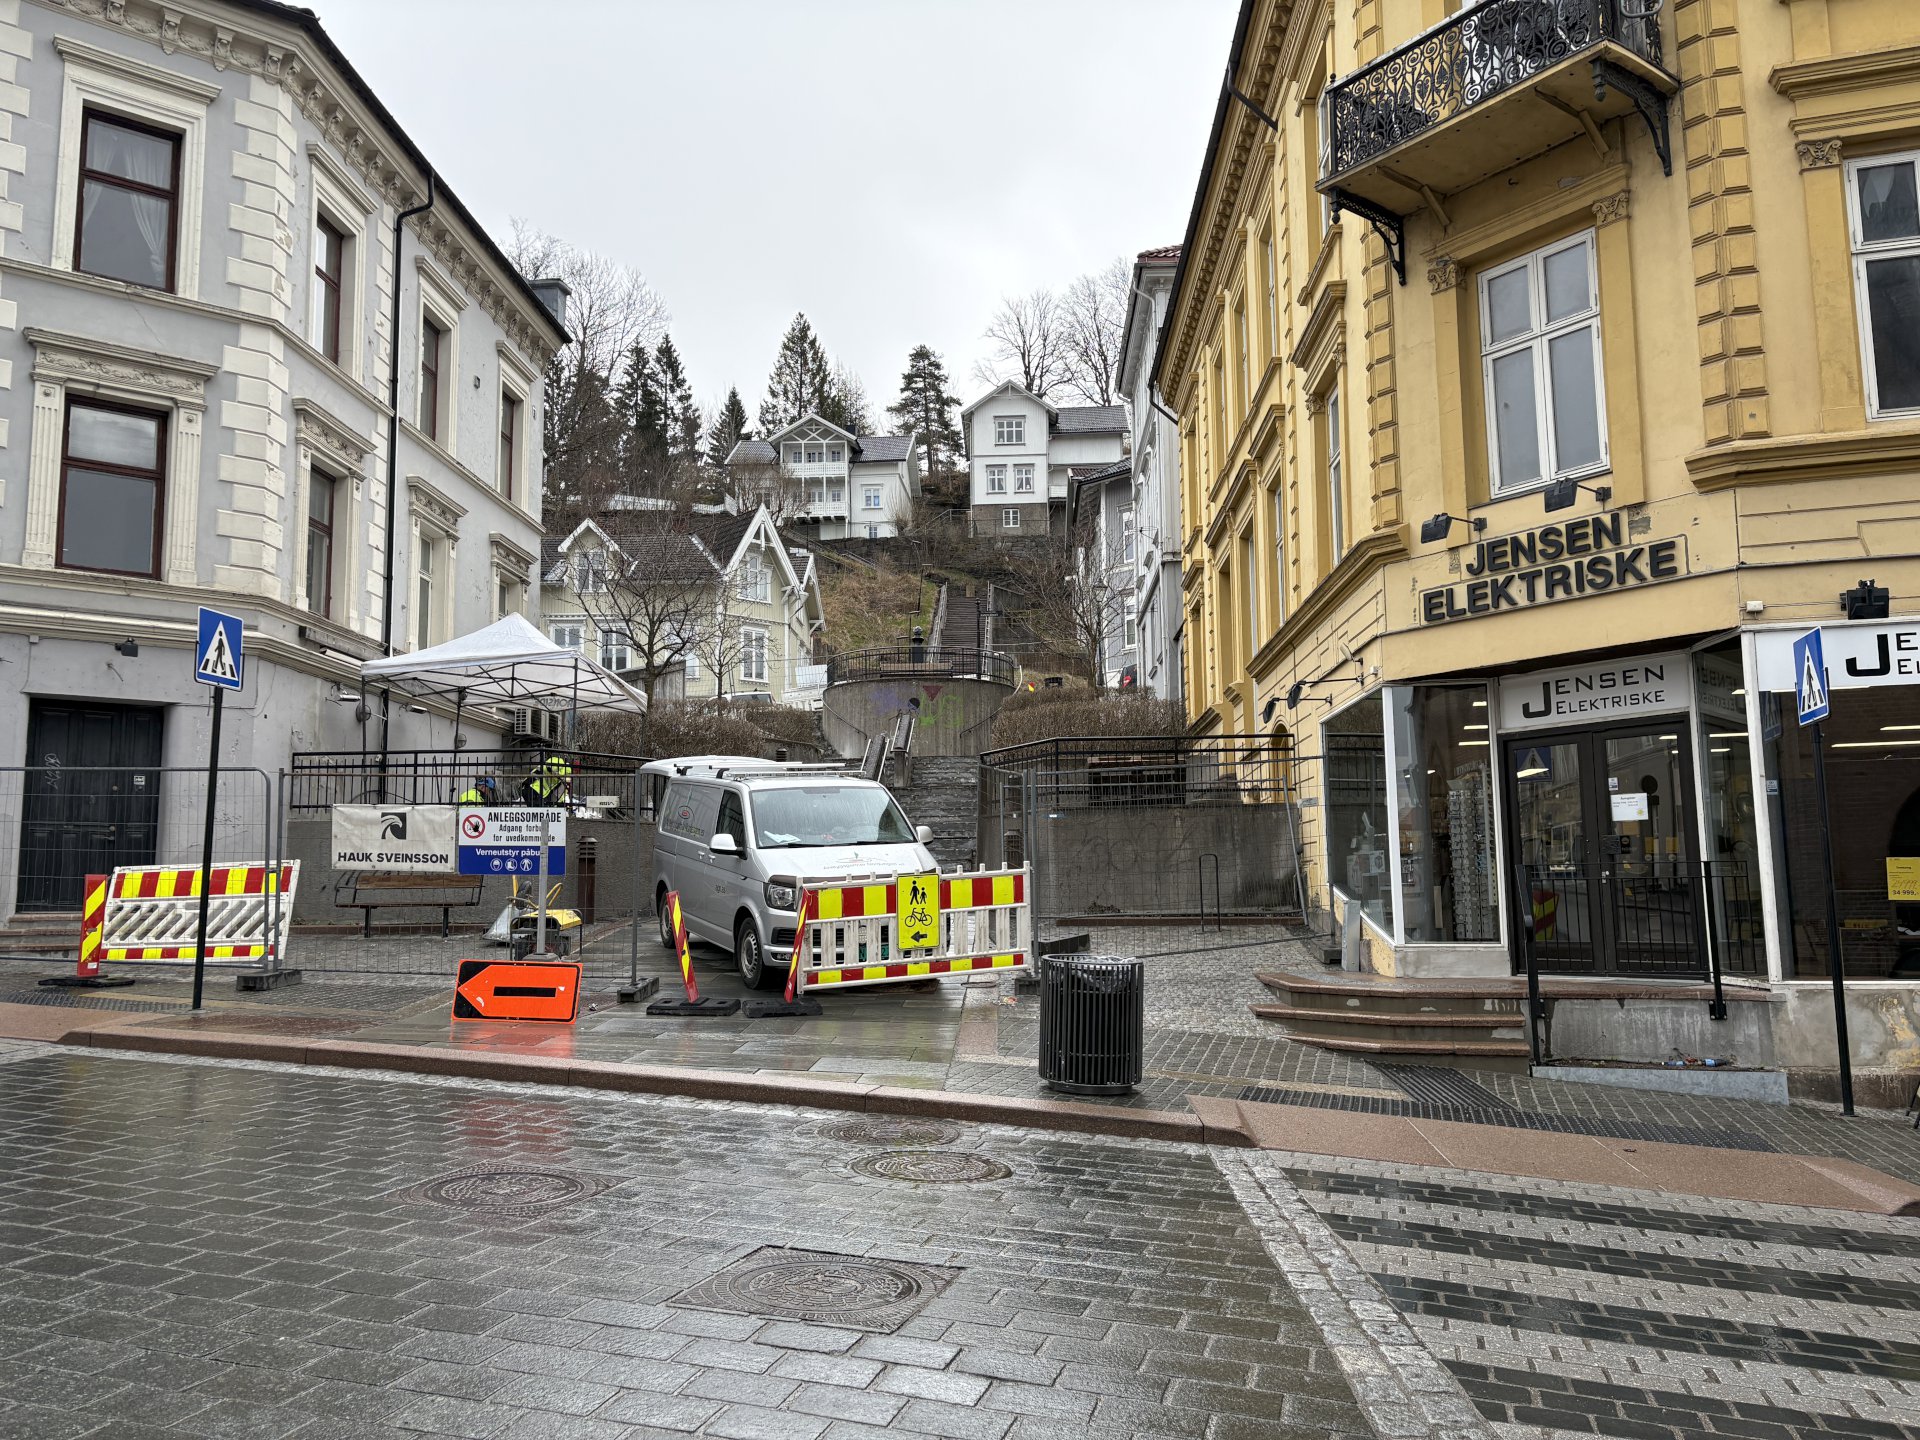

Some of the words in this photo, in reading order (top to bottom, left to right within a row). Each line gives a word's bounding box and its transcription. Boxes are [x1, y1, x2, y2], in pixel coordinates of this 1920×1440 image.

[1466, 512, 1622, 576] JENSEN
[1423, 540, 1678, 622] ELEKTRISKE
[1521, 664, 1665, 719] JENSEN
[1556, 690, 1665, 715] ELEKTRISKE
[487, 809, 562, 823] ANLEGGSOMRÅDE
[498, 824, 523, 833] Adgang
[493, 834, 503, 842] for
[506, 834, 556, 842] uvedkommde
[337, 852, 373, 862] HAUK
[376, 852, 449, 864] SVEINSSON
[476, 848, 520, 857] Verneutstyr
[521, 848, 541, 857] påbu
